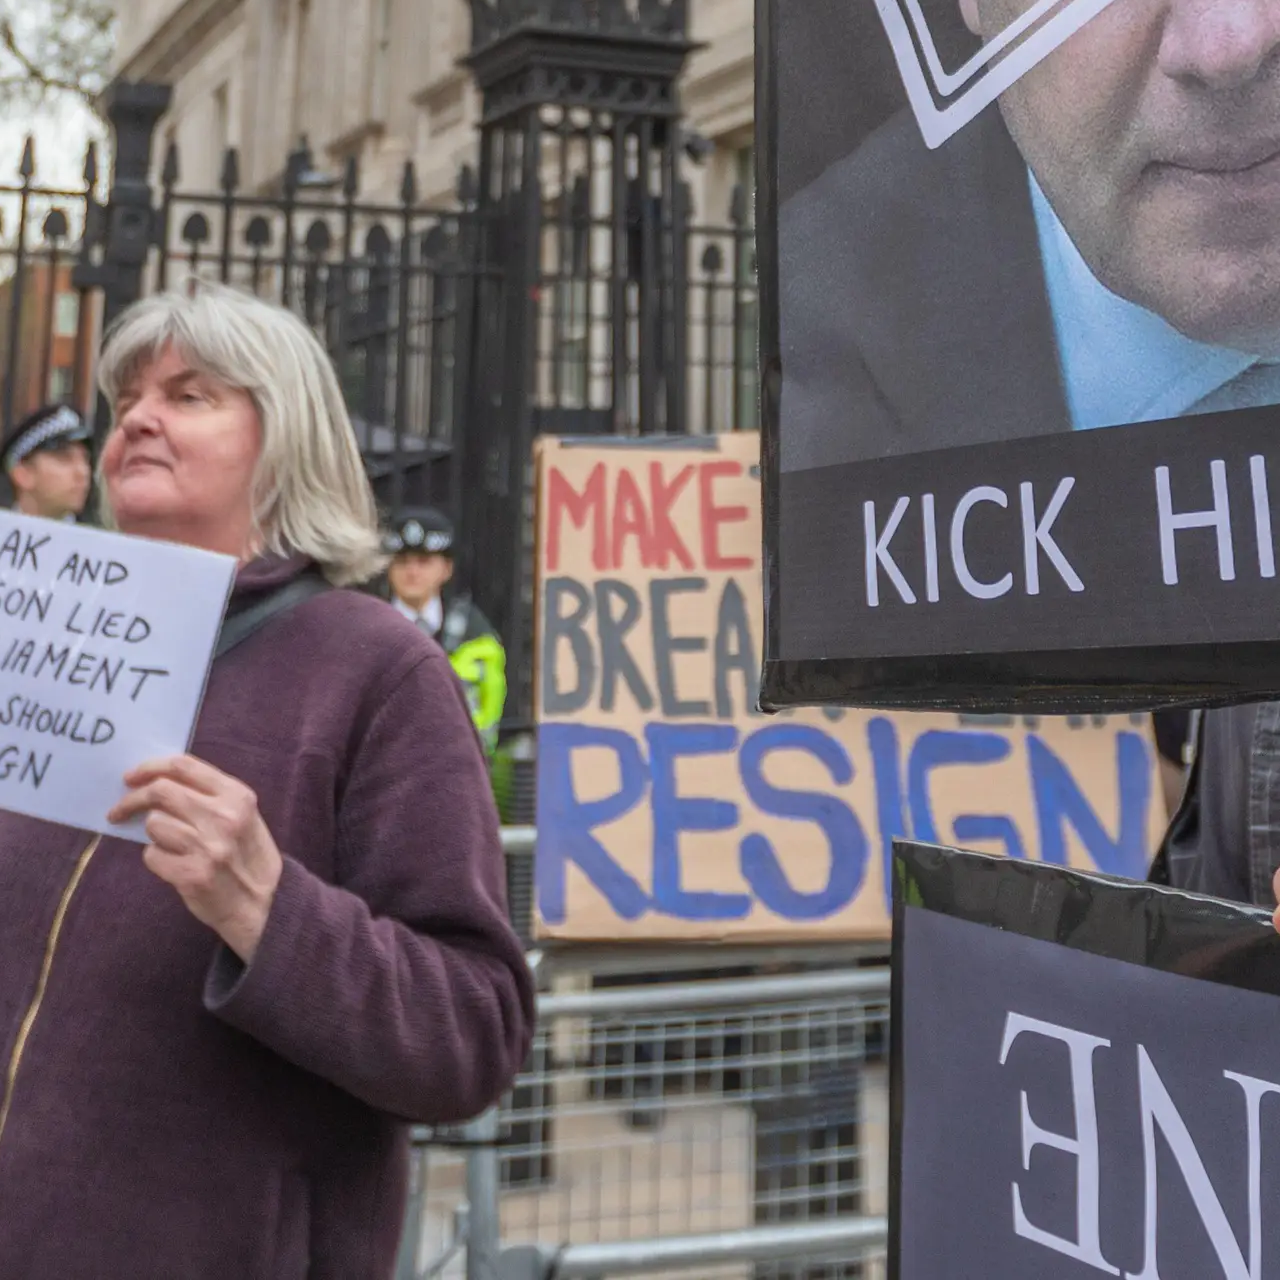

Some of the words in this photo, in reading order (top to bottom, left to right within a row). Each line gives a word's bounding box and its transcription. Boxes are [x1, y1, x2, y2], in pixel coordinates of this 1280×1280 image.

[56, 552, 129, 586] AND
[545, 461, 755, 572] MAKE
[863, 476, 1085, 607] KICK
[66, 602, 152, 644] LIED
[542, 576, 846, 723] BREA
[533, 716, 1153, 925] RESIGN
